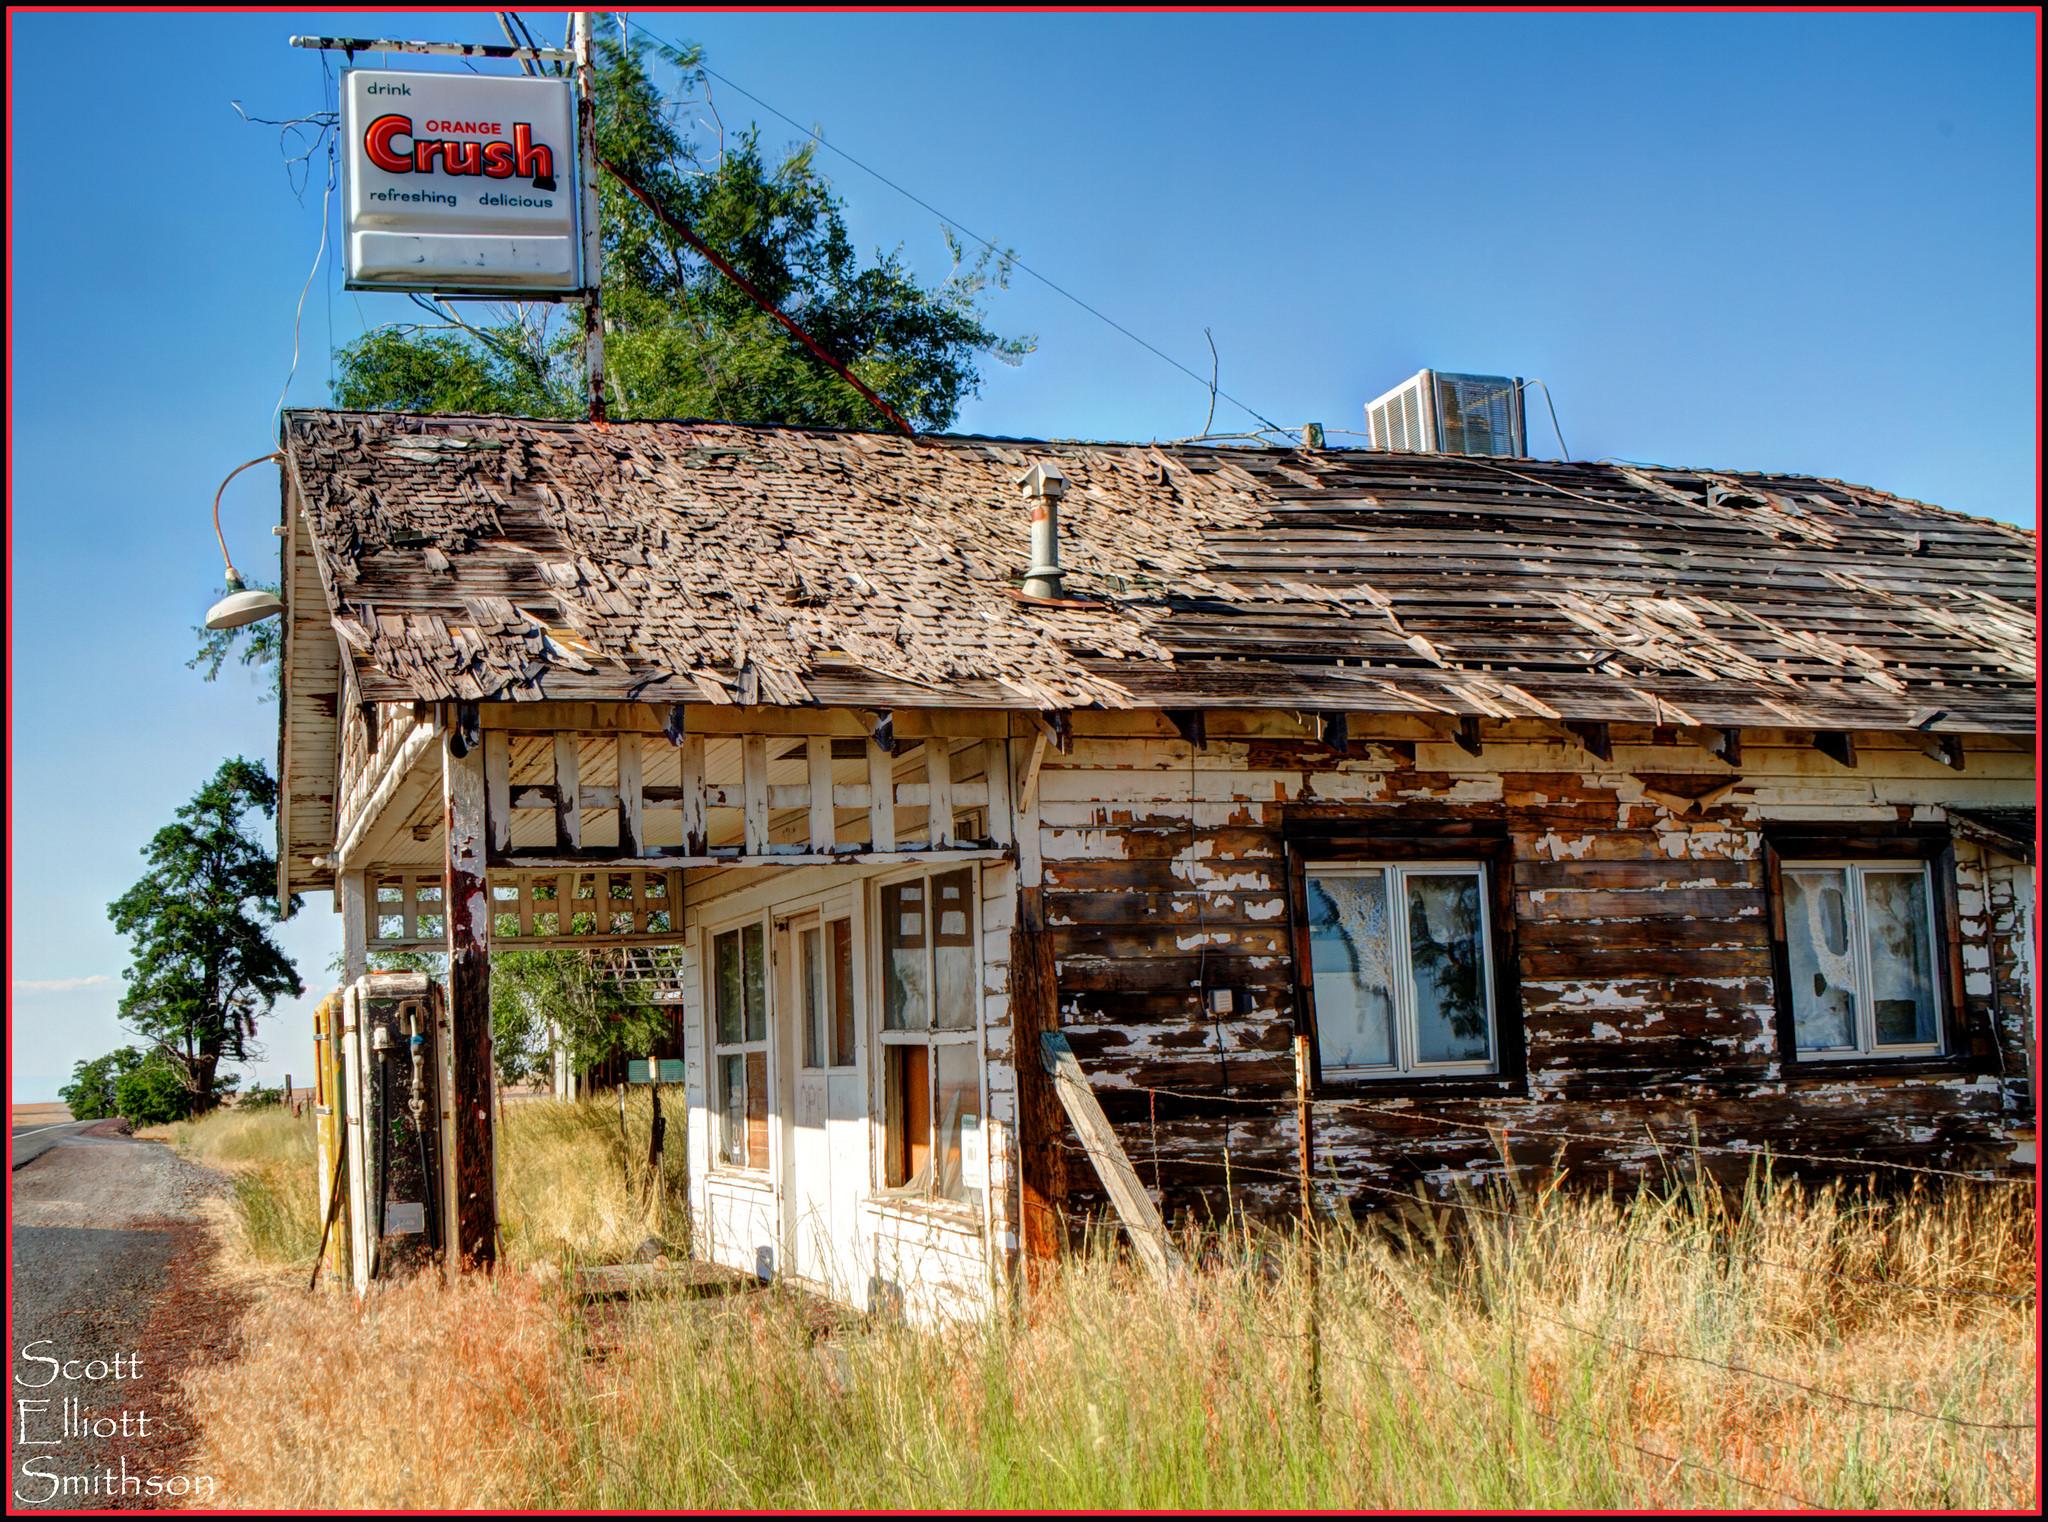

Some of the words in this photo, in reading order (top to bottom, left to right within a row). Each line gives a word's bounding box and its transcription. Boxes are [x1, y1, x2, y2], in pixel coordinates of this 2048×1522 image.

[367, 82, 411, 96] drink
[426, 120, 502, 135] ORANGE
[363, 114, 554, 179] Crush
[369, 189, 457, 206] refreshing
[479, 193, 553, 208] delicious
